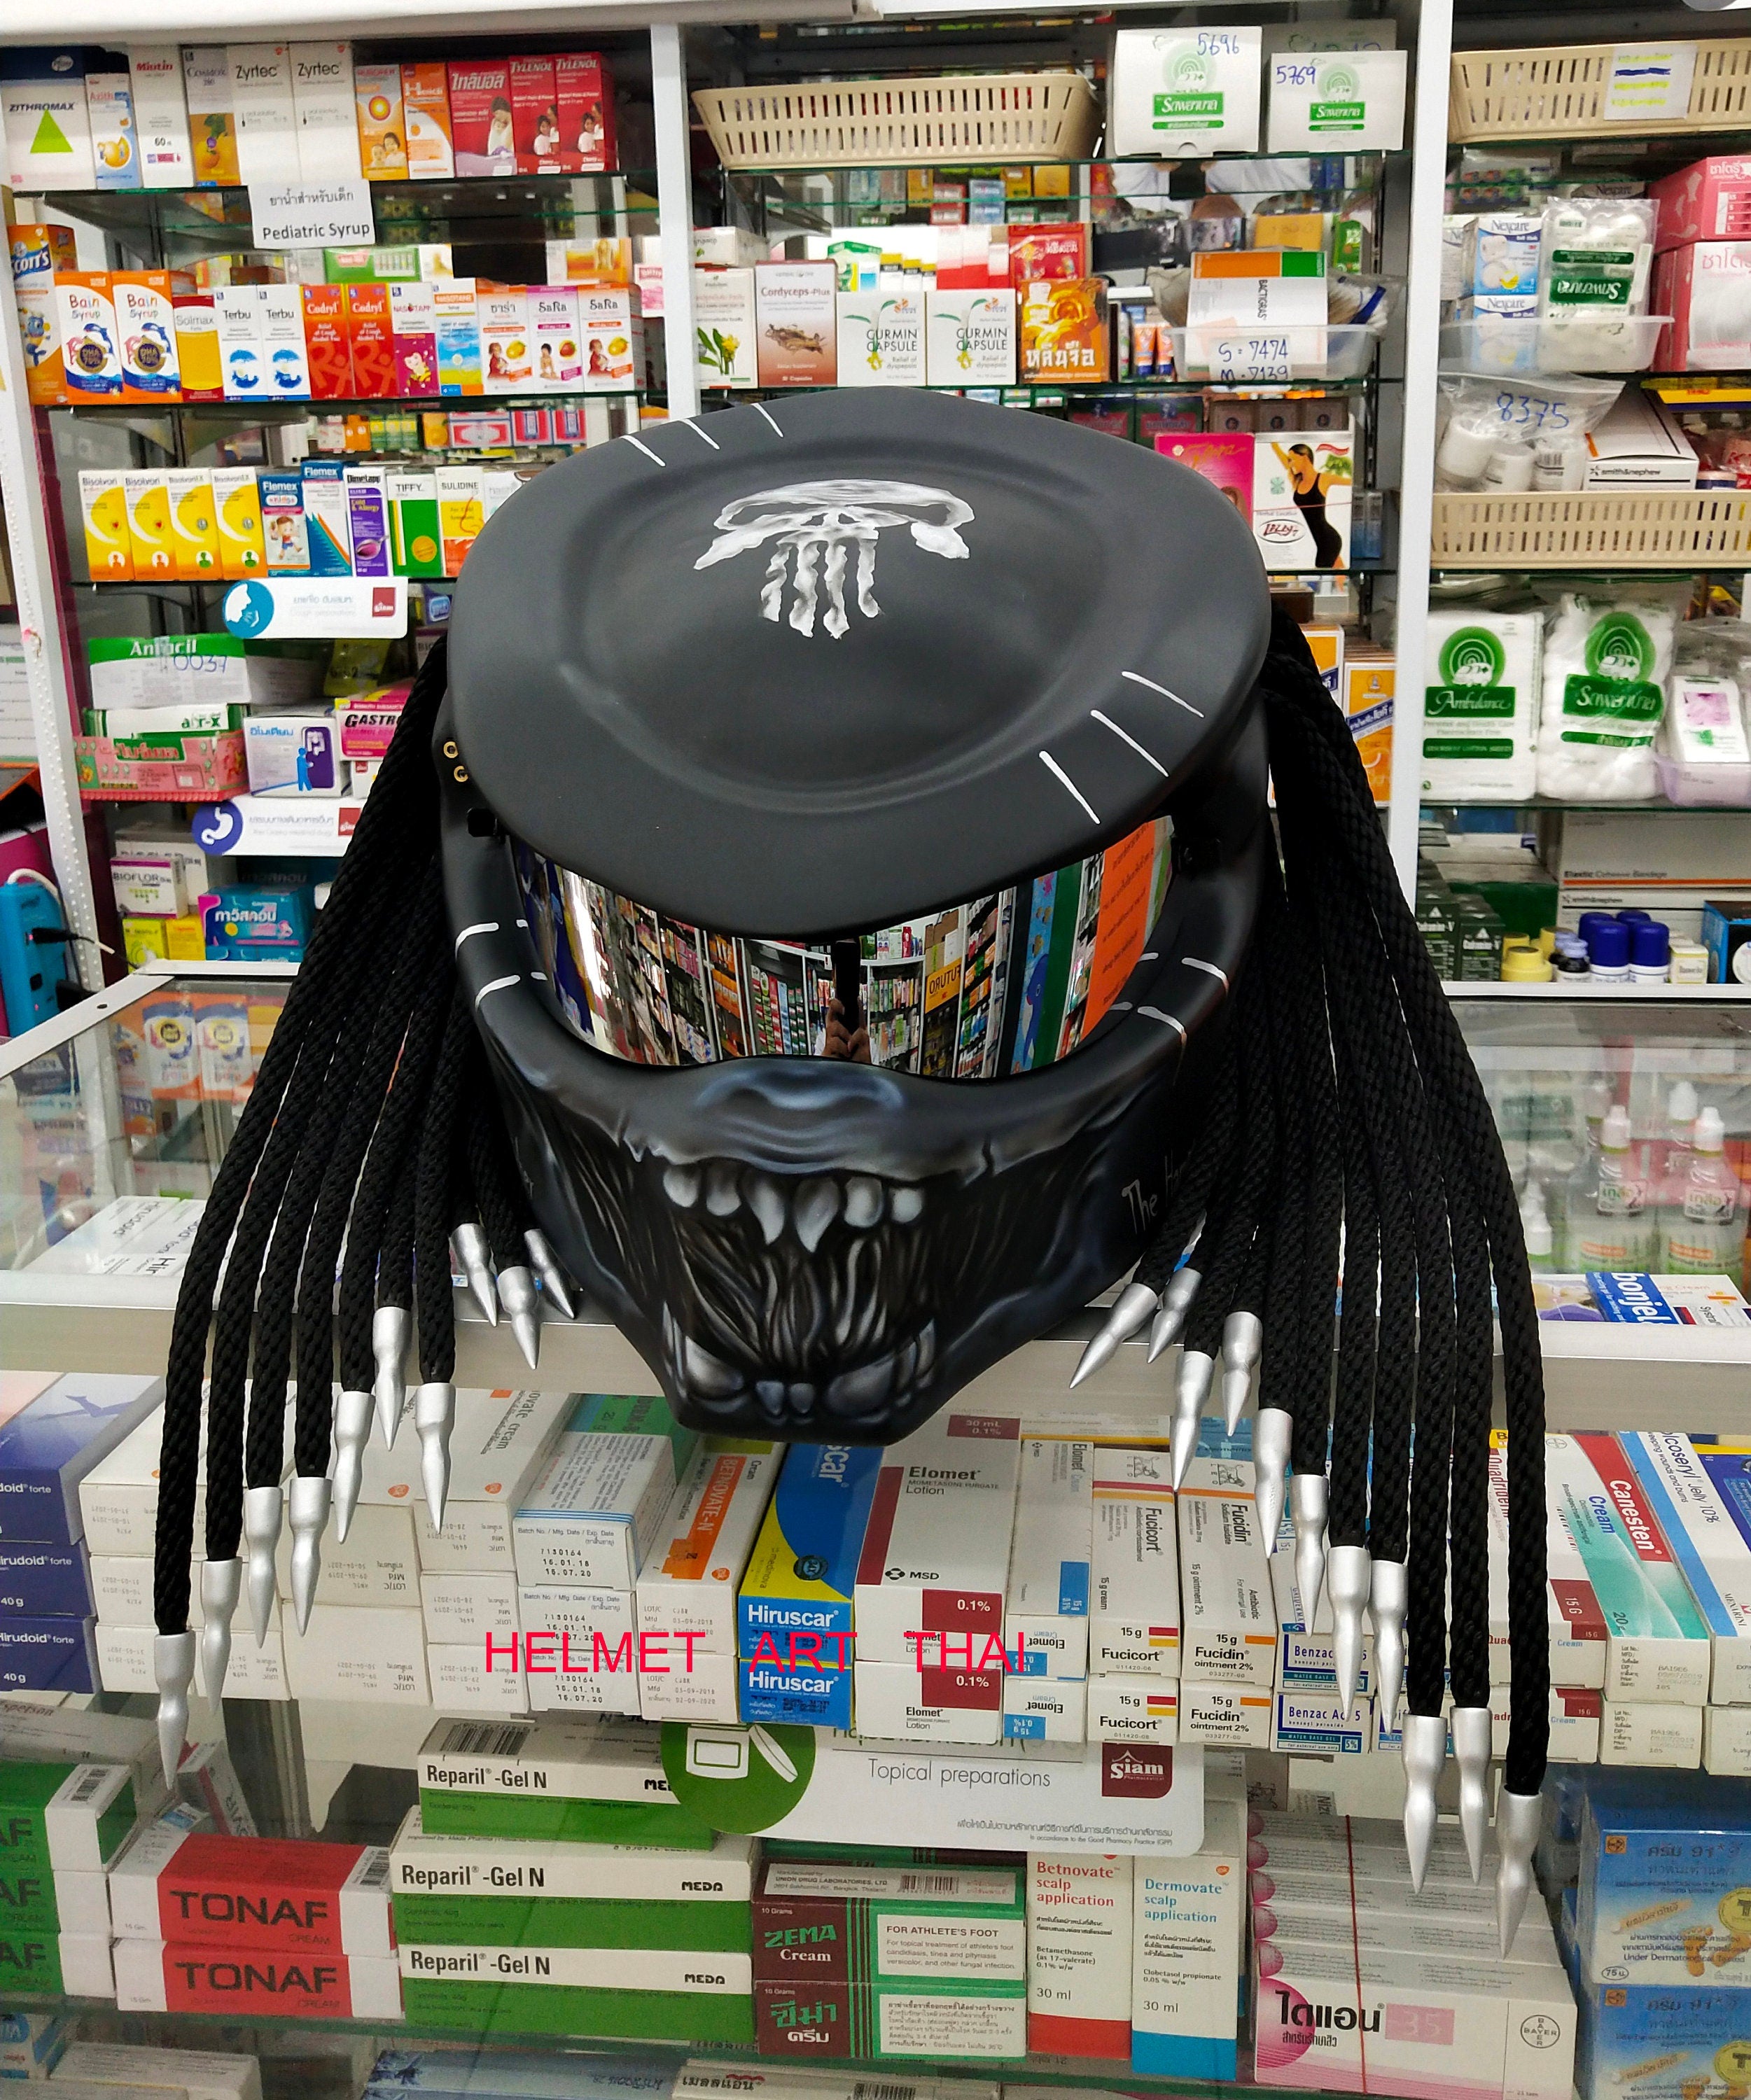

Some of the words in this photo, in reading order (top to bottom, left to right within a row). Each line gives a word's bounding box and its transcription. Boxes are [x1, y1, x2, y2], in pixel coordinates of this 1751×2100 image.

[1197, 34, 1239, 56] 5696
[511, 62, 552, 73] TYLENOL
[557, 59, 598, 71] TYLENOL
[236, 63, 276, 86] Zyrtec
[298, 62, 338, 84] Zyrtec
[1276, 66, 1316, 85] 5769
[9, 102, 75, 111] ZITHROMAX
[1491, 219, 1531, 233] Nexcare
[263, 230, 326, 248] Pediatric
[330, 223, 370, 246] Syrup
[69, 293, 100, 310] Bain
[127, 293, 158, 310] Bain
[761, 287, 809, 304] Cordyceps
[1257, 279, 1269, 319] BACTIGRAS
[539, 301, 567, 321] SaRa
[590, 298, 618, 318] SaRa
[1487, 297, 1526, 312] Nexcare
[71, 309, 101, 326] Syrup
[130, 309, 158, 326] Syrup
[224, 309, 251, 322] Terbu
[266, 309, 294, 322] Terbu
[176, 315, 214, 333] Solmax
[867, 341, 919, 352] CAPSULE
[956, 340, 1008, 351] CAPSULE
[1497, 392, 1570, 430] 8375
[305, 465, 338, 477] Flemex
[1601, 468, 1661, 478] smith&nephew
[83, 476, 118, 491] Bisolvon
[125, 476, 161, 491] Bisolvon
[263, 480, 298, 493] Flemex
[347, 474, 382, 485] Dimetapp
[441, 481, 480, 491] SULIDINE
[396, 483, 423, 493] TIFFY
[174, 653, 226, 673] 0037
[1428, 690, 1513, 715] Ambulance
[113, 871, 160, 885] BIOFLOR
[1565, 870, 1593, 878] Elastic
[1122, 1179, 1158, 1235] The
[1072, 1443, 1088, 1473] Elomet
[909, 1466, 977, 1480] Elomet
[29, 1485, 51, 1494] forte
[697, 1455, 744, 1533] BETNOVATE-N
[906, 1485, 945, 1496] Lotion
[1589, 1495, 1617, 1534] Cream
[1610, 1480, 1658, 1552] Canesten
[1699, 1504, 1722, 1525] 10%
[1145, 1506, 1164, 1554] Fucicort
[1232, 1504, 1249, 1544] Fucidin
[541, 1548, 582, 1557] 7130164
[50, 1556, 72, 1566] forte
[909, 1572, 940, 1581] MSD
[956, 1599, 991, 1612] 0.1%
[748, 1604, 835, 1628] Hiruscar
[53, 1634, 75, 1645] forte
[1034, 1630, 1057, 1639] Cream
[1120, 1627, 1133, 1636] 15
[1134, 1629, 1142, 1639] g
[1215, 1634, 1228, 1643] 15
[1229, 1636, 1237, 1646] g
[1028, 1637, 1065, 1649] Elomet
[1557, 1639, 1583, 1648] Cream
[1101, 1648, 1160, 1661] Fucicort
[1195, 1646, 1245, 1660] Fucidin
[1194, 1660, 1237, 1670] ointment
[1239, 1662, 1253, 1671] 2%
[749, 1671, 835, 1693] Hiruscar
[956, 1674, 990, 1688] 0.1%
[1033, 1695, 1056, 1704] Cream
[906, 1706, 944, 1718] Elomet
[1026, 1702, 1063, 1714] Elomet
[1190, 1709, 1241, 1722] Fucidin
[906, 1721, 930, 1730] Lotion
[1100, 1716, 1159, 1730] Fucicort
[1190, 1722, 1233, 1732] ointment
[1234, 1723, 1250, 1732] 2%
[1551, 1716, 1577, 1725] Cream
[426, 1765, 486, 1788] Reparil
[494, 1772, 529, 1788] -Gel
[533, 1774, 547, 1789] N
[868, 1757, 933, 1783] Topical
[940, 1765, 1051, 1790] preparations
[1110, 1763, 1164, 1784] Siam
[1036, 1861, 1114, 1878] Betnovate
[401, 1865, 472, 1890] Reparil
[482, 1867, 522, 1888] -Gel
[529, 1868, 545, 1888] N
[681, 1881, 723, 1892] MEDA
[1036, 1879, 1071, 1896] scalp
[1144, 1878, 1222, 1895] Dermovate
[1036, 1891, 1115, 1908] application
[1144, 1894, 1177, 1910] scalp
[169, 1890, 329, 1928] TONAF
[1144, 1909, 1218, 1925] application
[765, 1924, 837, 1949] ZEMA
[886, 1925, 908, 1934] FOR
[910, 1926, 967, 1937] ATHLETE'S
[970, 1928, 999, 1938] FOOT
[288, 1933, 330, 1946] CREAM
[779, 1948, 832, 1963] Cream
[411, 1950, 479, 1975] Reparil
[489, 1954, 530, 1974] -Gel
[536, 1956, 550, 1975] N
[684, 1973, 725, 1985] MEDA
[174, 1961, 337, 1994] TONAF
[1036, 1987, 1052, 1998] 30
[1056, 1989, 1072, 2001] ml
[297, 1998, 340, 2010] CREAM
[1143, 2001, 1159, 2012] 30
[1163, 2002, 1179, 2014] ml
[1274, 1989, 1380, 2033] ไดแอน
[769, 1999, 837, 2029] ซีม่า
[787, 2029, 830, 2044] ครีม
